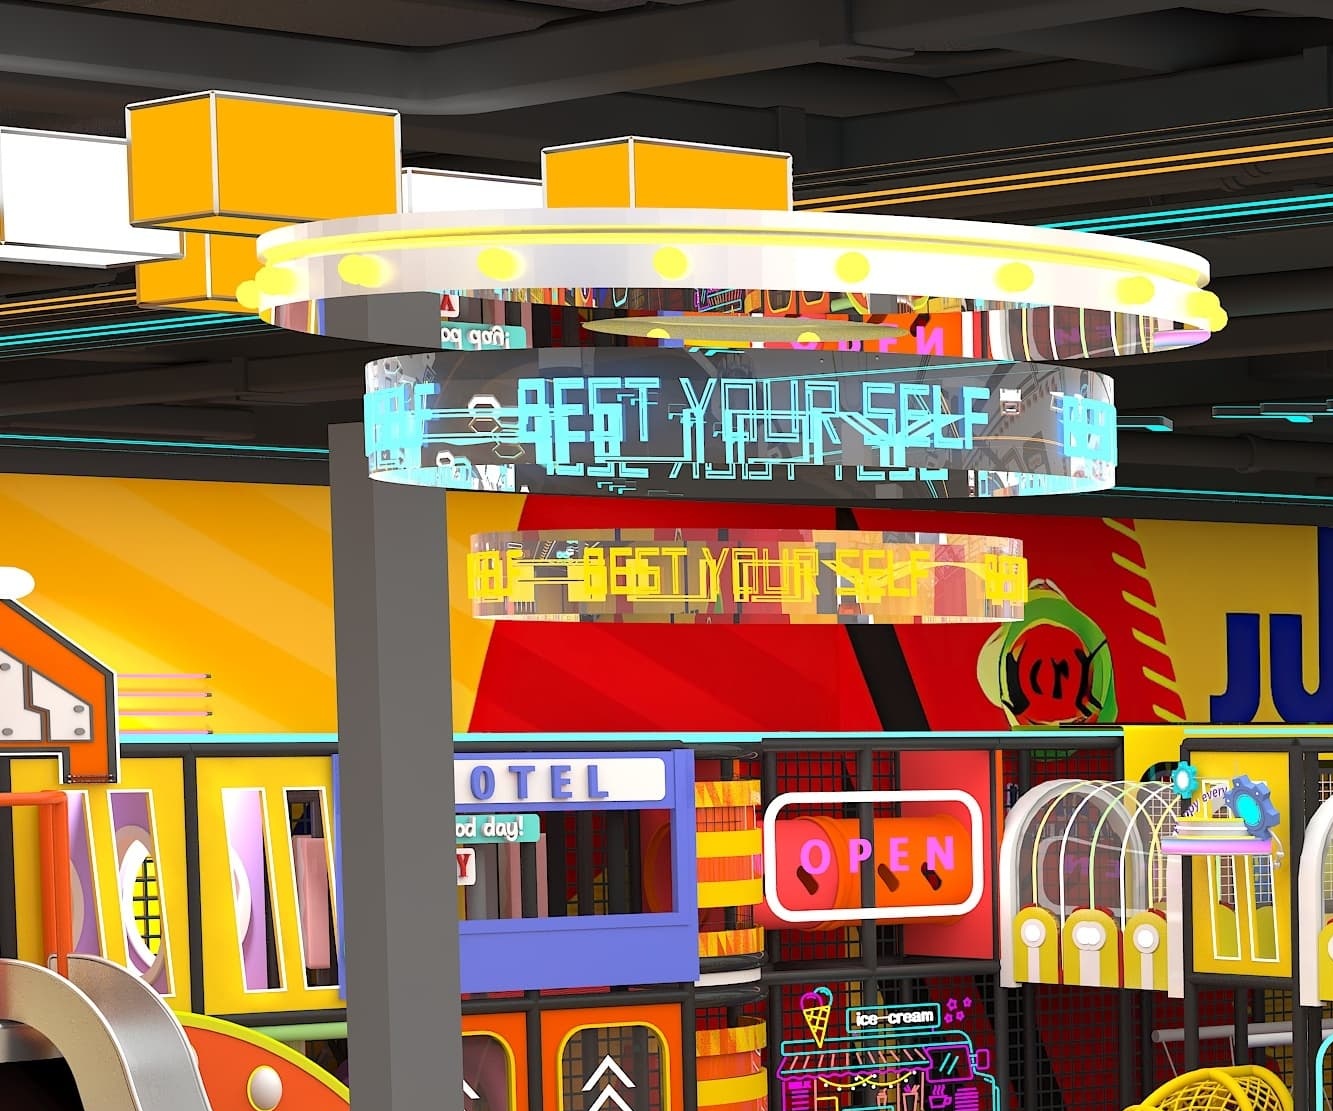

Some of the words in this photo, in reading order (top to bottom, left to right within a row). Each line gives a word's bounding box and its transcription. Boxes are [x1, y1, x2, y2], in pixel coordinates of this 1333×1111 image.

[470, 765, 609, 800] OTEL
[456, 816, 477, 837] od
[484, 816, 524, 841] day!
[800, 836, 955, 875] OPEN
